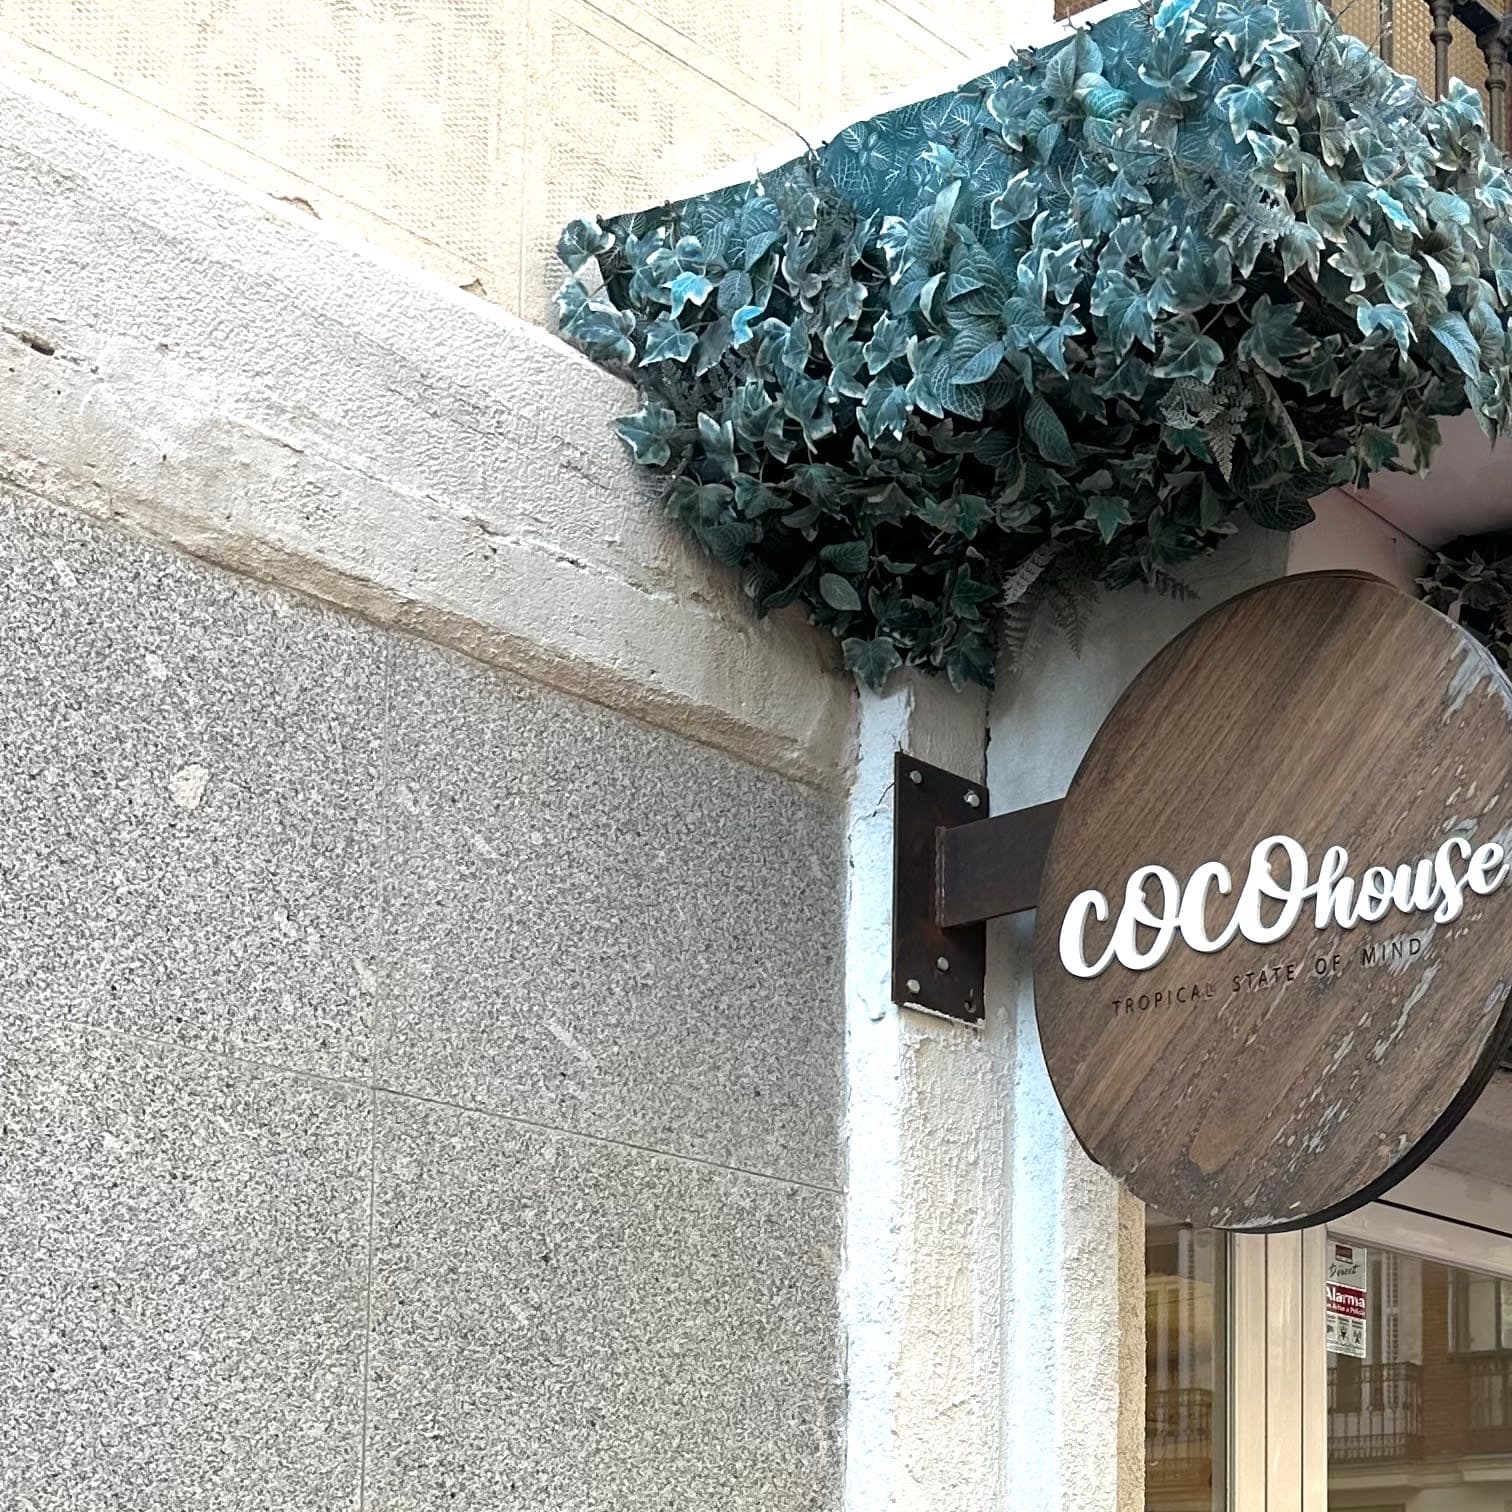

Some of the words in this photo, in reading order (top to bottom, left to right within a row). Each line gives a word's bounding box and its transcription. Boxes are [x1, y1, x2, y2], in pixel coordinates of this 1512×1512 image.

[1112, 982, 1216, 1017] TROPICAL
[1232, 963, 1295, 994] STATE
[1315, 954, 1342, 977] OF
[1362, 937, 1422, 967] MIND
[1326, 1286, 1365, 1308] Alarma
